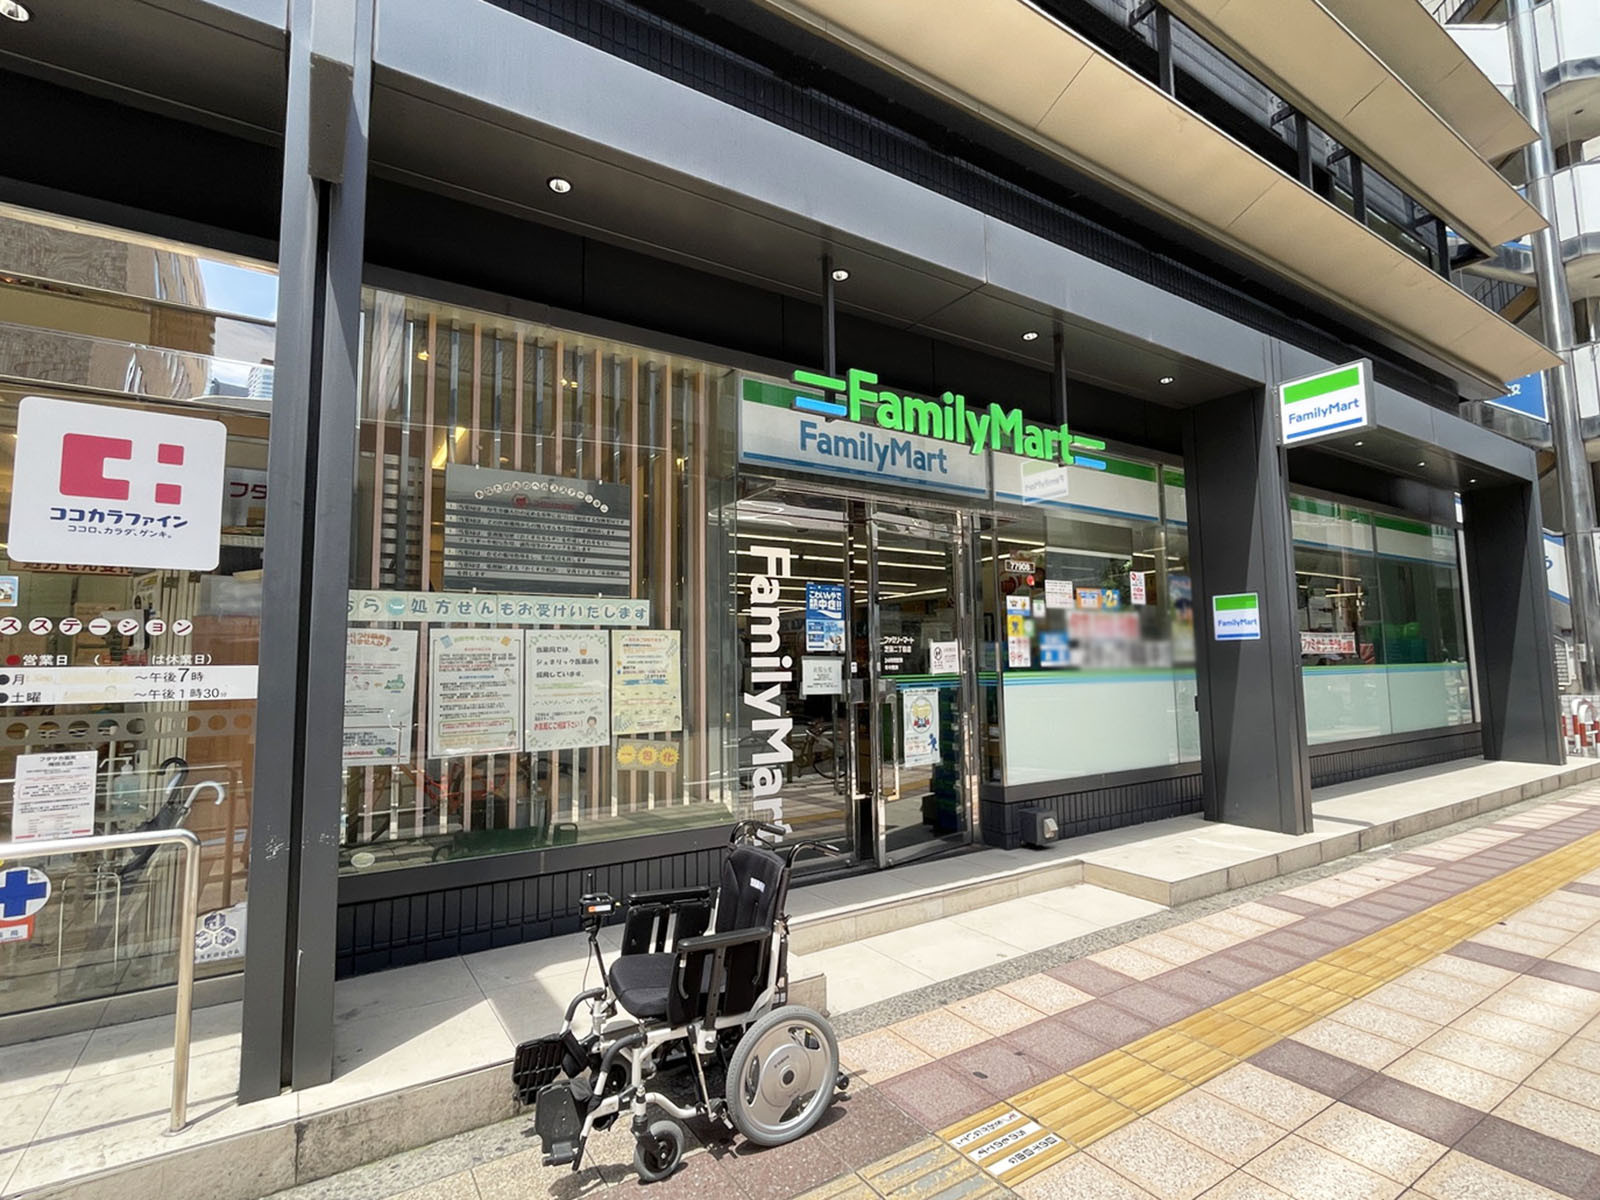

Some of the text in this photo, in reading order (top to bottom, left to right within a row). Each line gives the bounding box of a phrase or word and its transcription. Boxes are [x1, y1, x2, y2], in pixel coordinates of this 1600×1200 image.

[848, 368, 1074, 465] FamilyMart
[1288, 398, 1360, 424] FamilyMart
[800, 420, 948, 474] FamilyMart
[50, 507, 188, 529] ココカラファイン
[67, 524, 173, 539] ココロ、カラダ、ゲンキ。
[411, 600, 648, 620] 処方せんもお受けいたします
[1217, 616, 1257, 628] FamilyMart
[22, 654, 68, 666] 営業日
[11, 691, 42, 703] 土曜
[744, 544, 793, 845] FamilyMart
